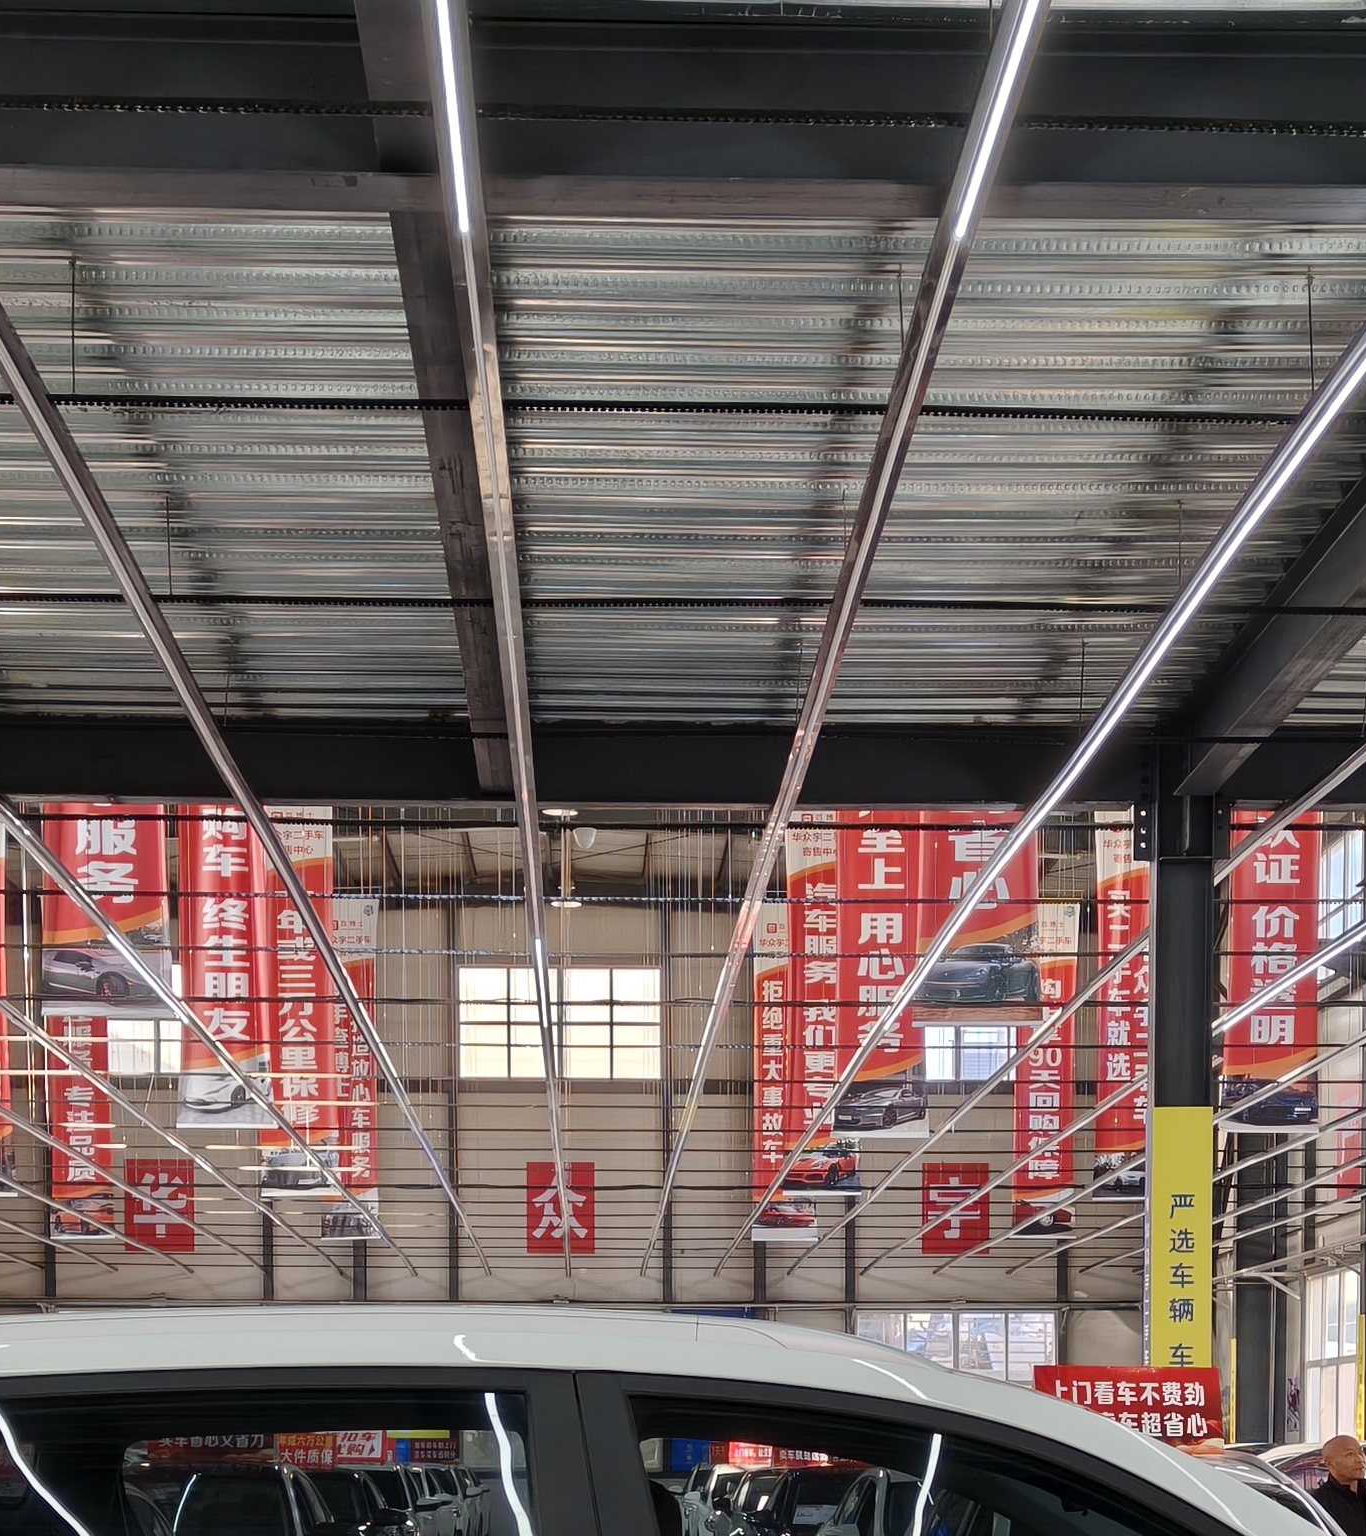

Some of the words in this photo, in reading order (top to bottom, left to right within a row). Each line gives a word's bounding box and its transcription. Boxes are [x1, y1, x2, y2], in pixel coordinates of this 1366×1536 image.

[76, 803, 138, 904] 服务
[276, 829, 324, 841] 众宇二手车
[792, 832, 837, 843] 华众宇二
[858, 811, 906, 889] 至上
[948, 811, 1011, 910] 省心
[1104, 839, 1133, 849] 华众宇
[202, 897, 250, 1042] 终生朋友
[762, 980, 784, 1164] 拒绝重大事故车
[133, 1172, 188, 1239] 华
[1169, 1193, 1196, 1323] 严选车辆
[1055, 1380, 1206, 1407] 上门看车不费劲
[279, 1448, 334, 1467] 大件质保
